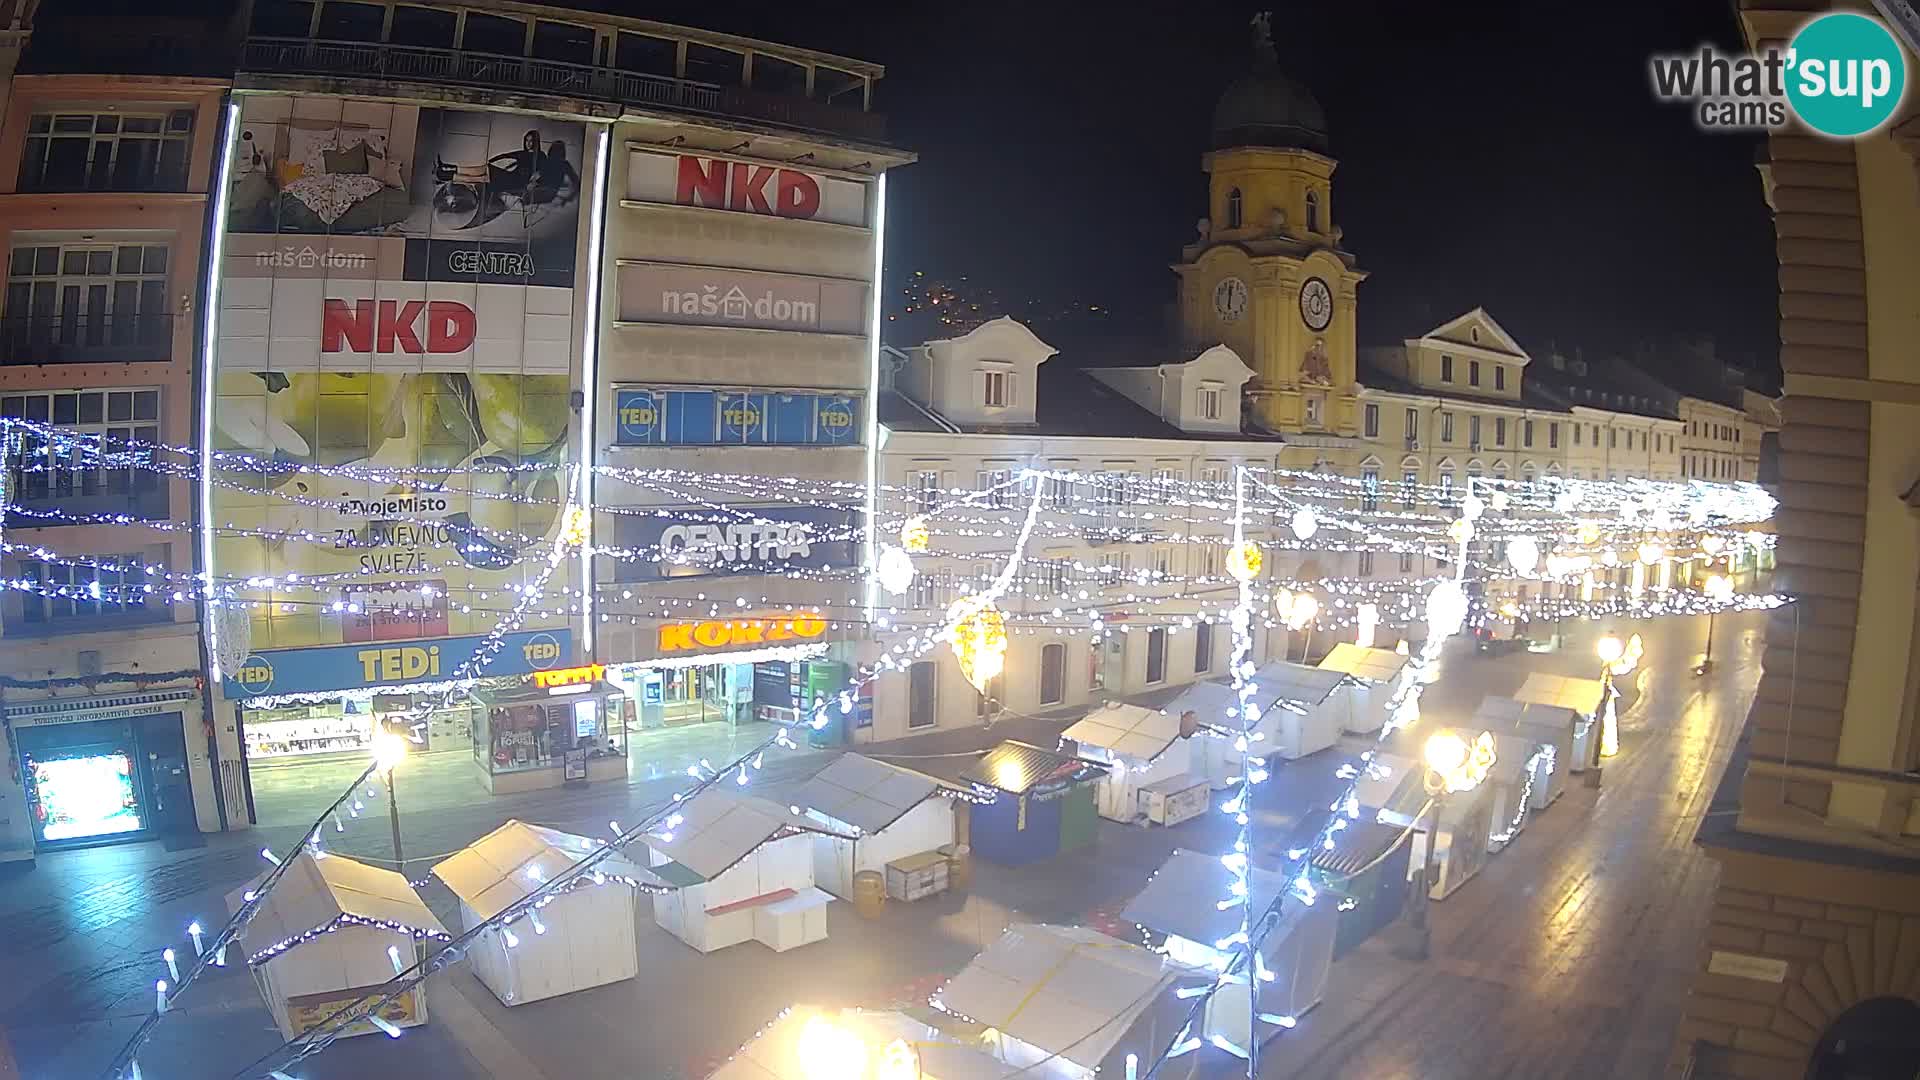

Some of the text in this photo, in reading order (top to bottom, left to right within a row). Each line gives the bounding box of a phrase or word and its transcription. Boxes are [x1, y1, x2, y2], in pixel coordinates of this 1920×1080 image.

[676, 155, 821, 219] NKD
[255, 247, 367, 269] naš dom
[449, 250, 536, 276] CENTRA
[662, 285, 816, 323] naš dom
[322, 298, 478, 354] NKD
[339, 497, 447, 516] #TvojeMisto
[335, 524, 450, 548] ZA DNEVNO
[660, 521, 811, 563] CENTRA
[658, 613, 828, 651] KORZO
[358, 646, 440, 682] TEDi
[534, 664, 605, 688] TOMMY
